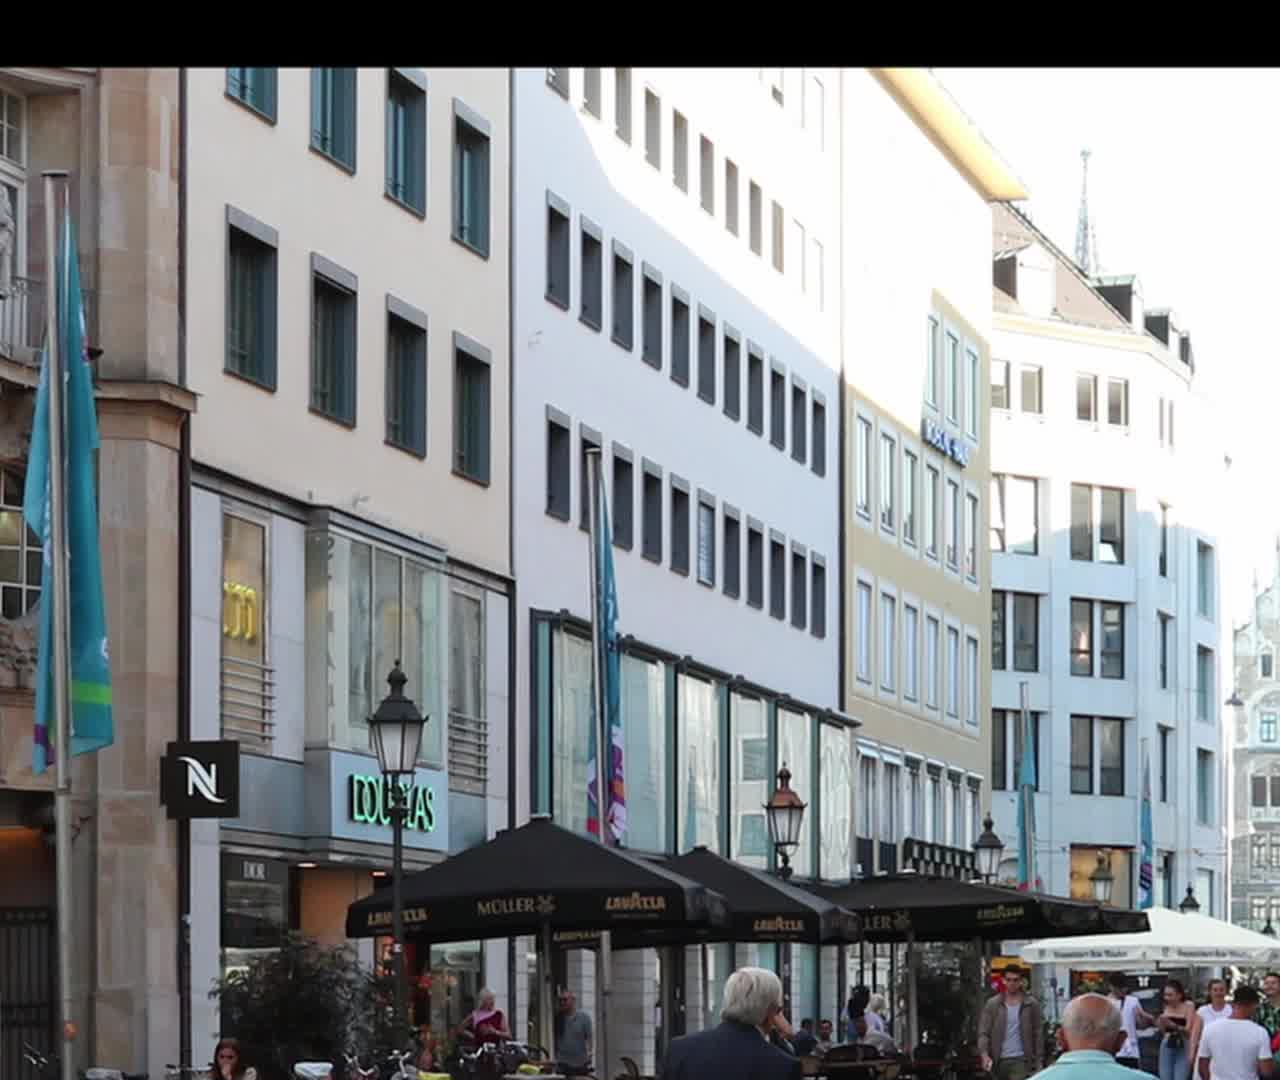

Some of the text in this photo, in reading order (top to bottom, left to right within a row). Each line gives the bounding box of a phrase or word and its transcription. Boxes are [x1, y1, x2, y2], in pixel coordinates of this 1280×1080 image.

[605, 891, 666, 911] LAVAZZA
[367, 907, 428, 926] LAVZZA
[752, 915, 804, 931] LAVAZZA
